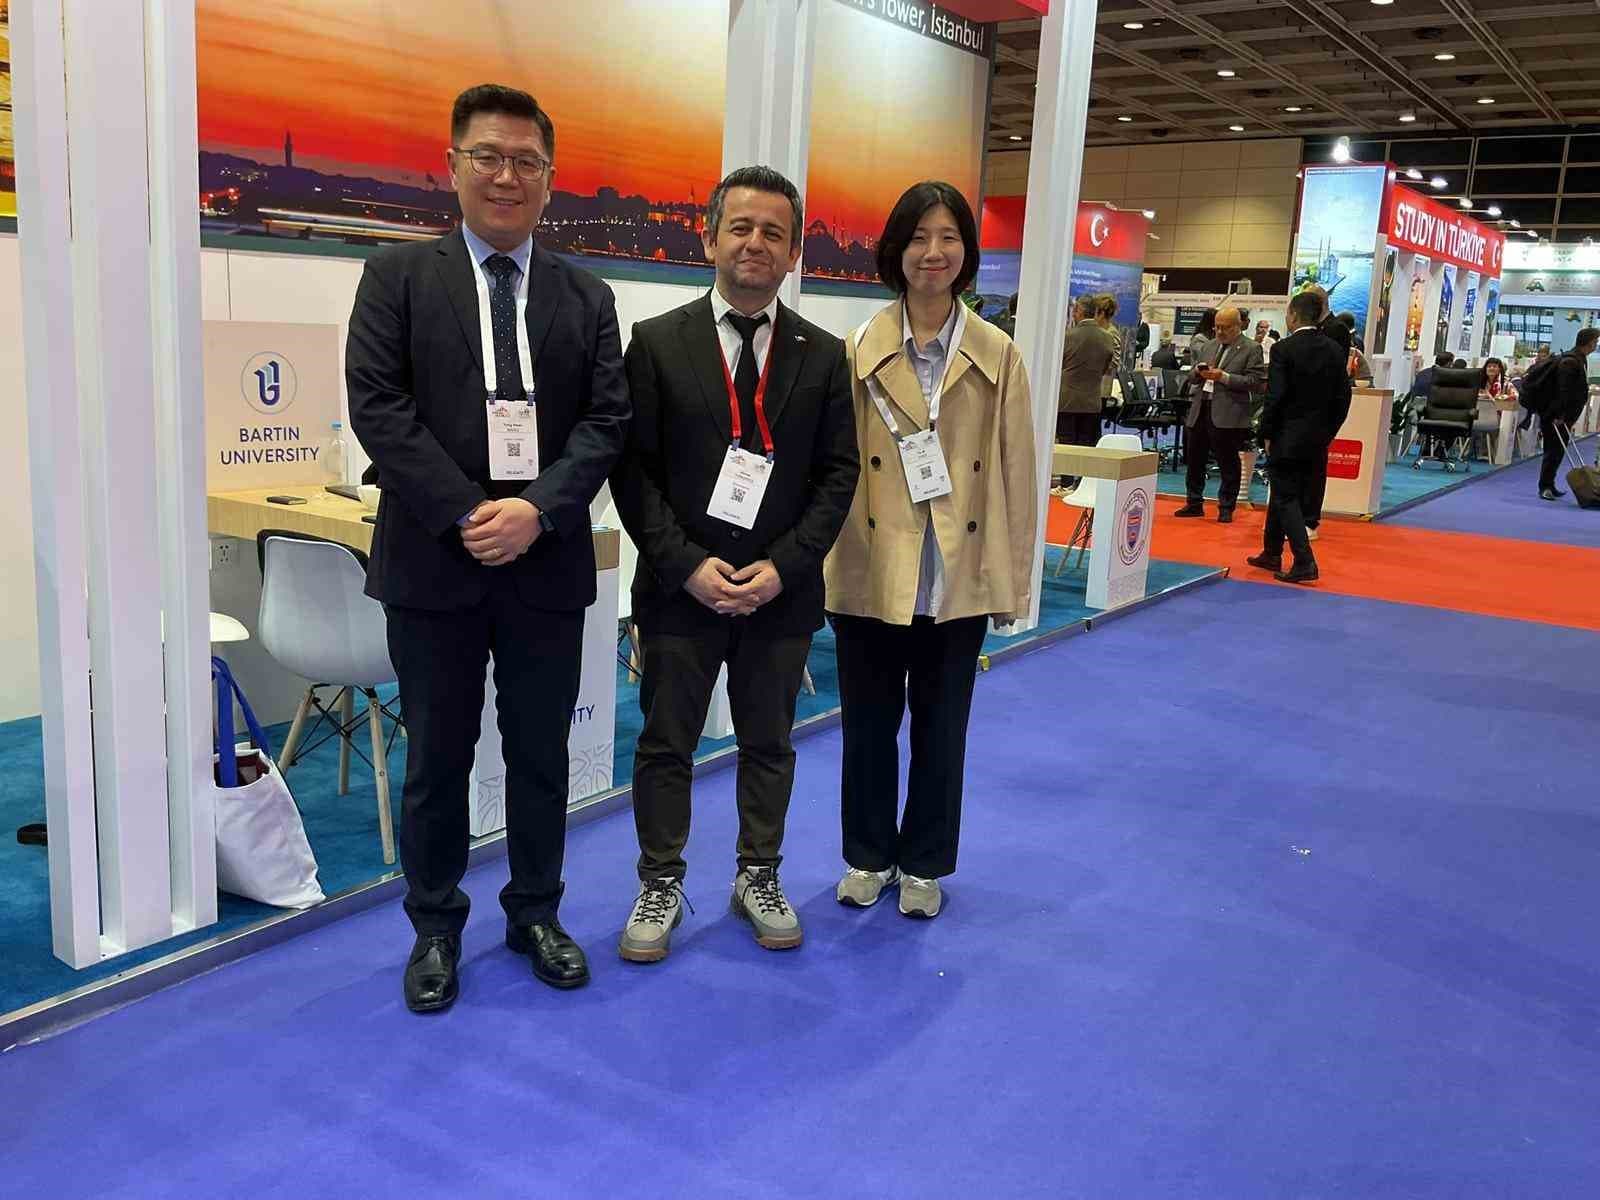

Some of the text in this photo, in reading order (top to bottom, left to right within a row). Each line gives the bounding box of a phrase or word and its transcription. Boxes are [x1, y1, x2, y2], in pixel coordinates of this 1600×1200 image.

[930, 3, 985, 51] İstanbul
[1394, 202, 1487, 267] STUDY IN TÜRKİYE
[239, 426, 300, 442] BARTIN
[220, 446, 320, 465] UNIVERSITY
